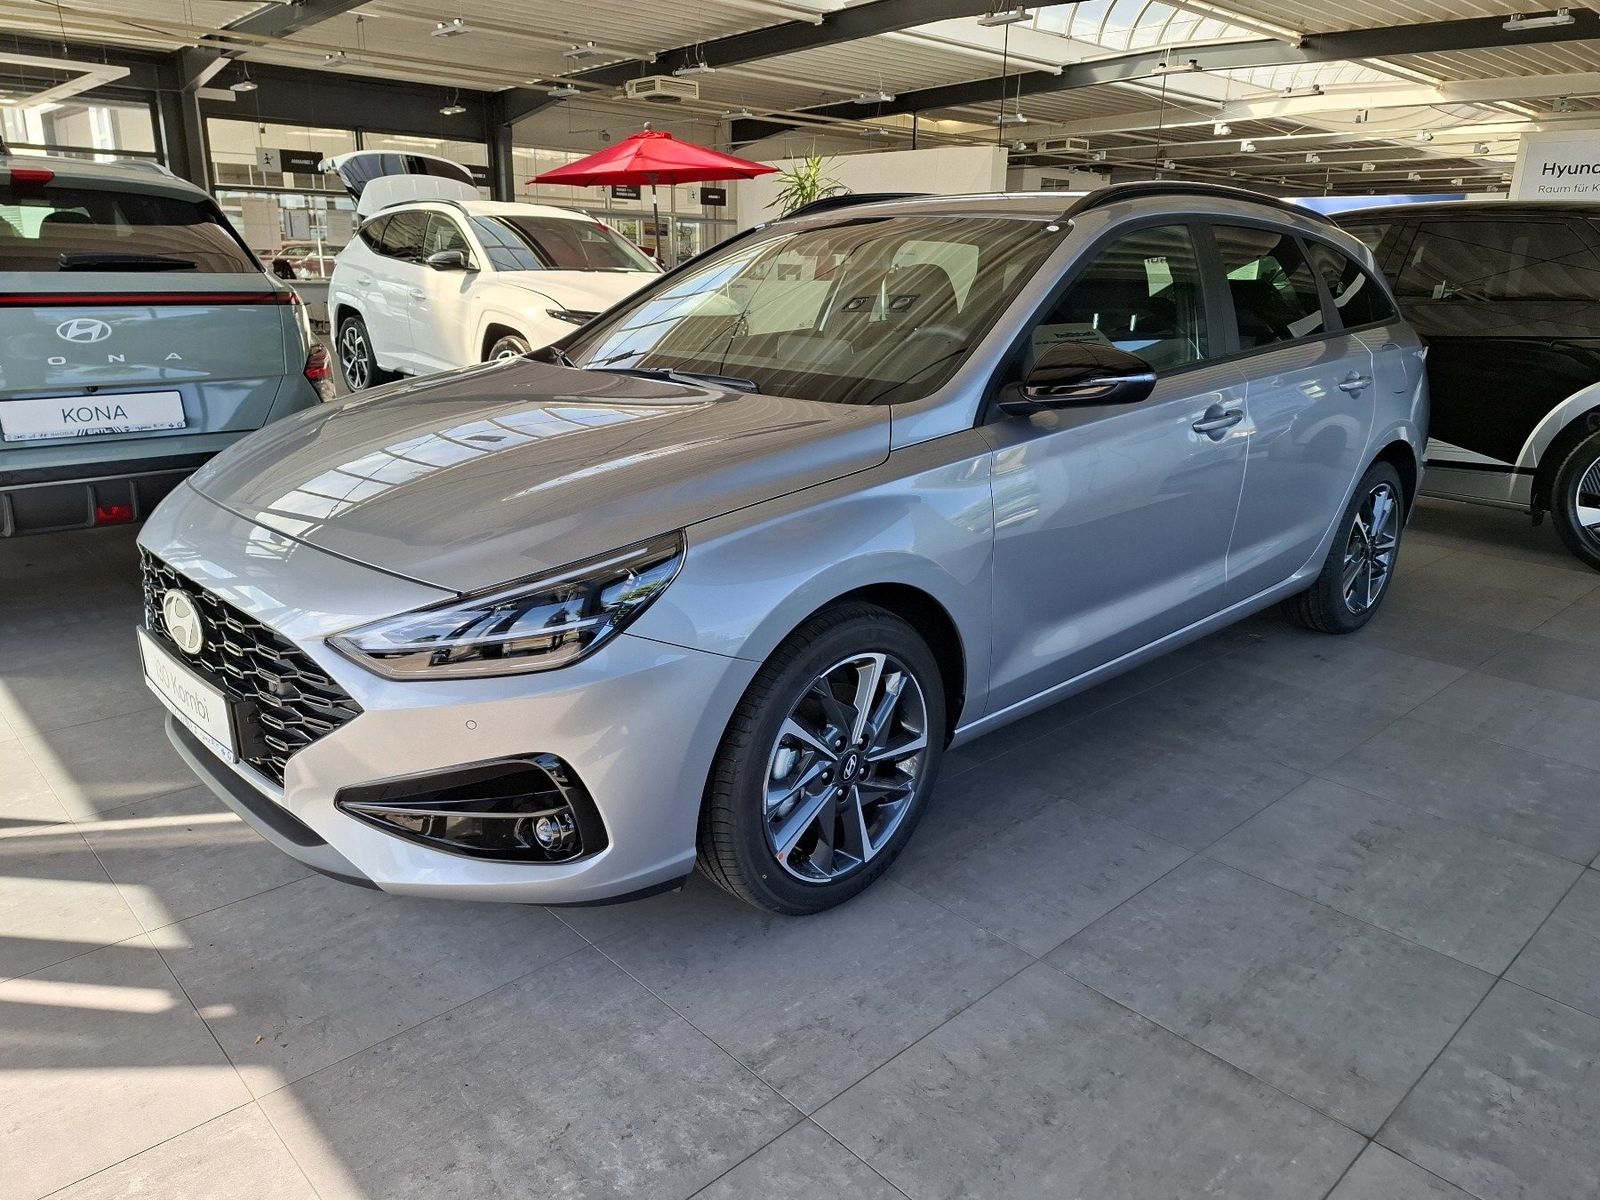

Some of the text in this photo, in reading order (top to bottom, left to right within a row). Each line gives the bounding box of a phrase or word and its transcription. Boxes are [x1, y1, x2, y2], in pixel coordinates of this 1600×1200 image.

[1538, 183, 1600, 193] Raum für K
[61, 404, 129, 424] KONA
[170, 672, 210, 723] Kombi
